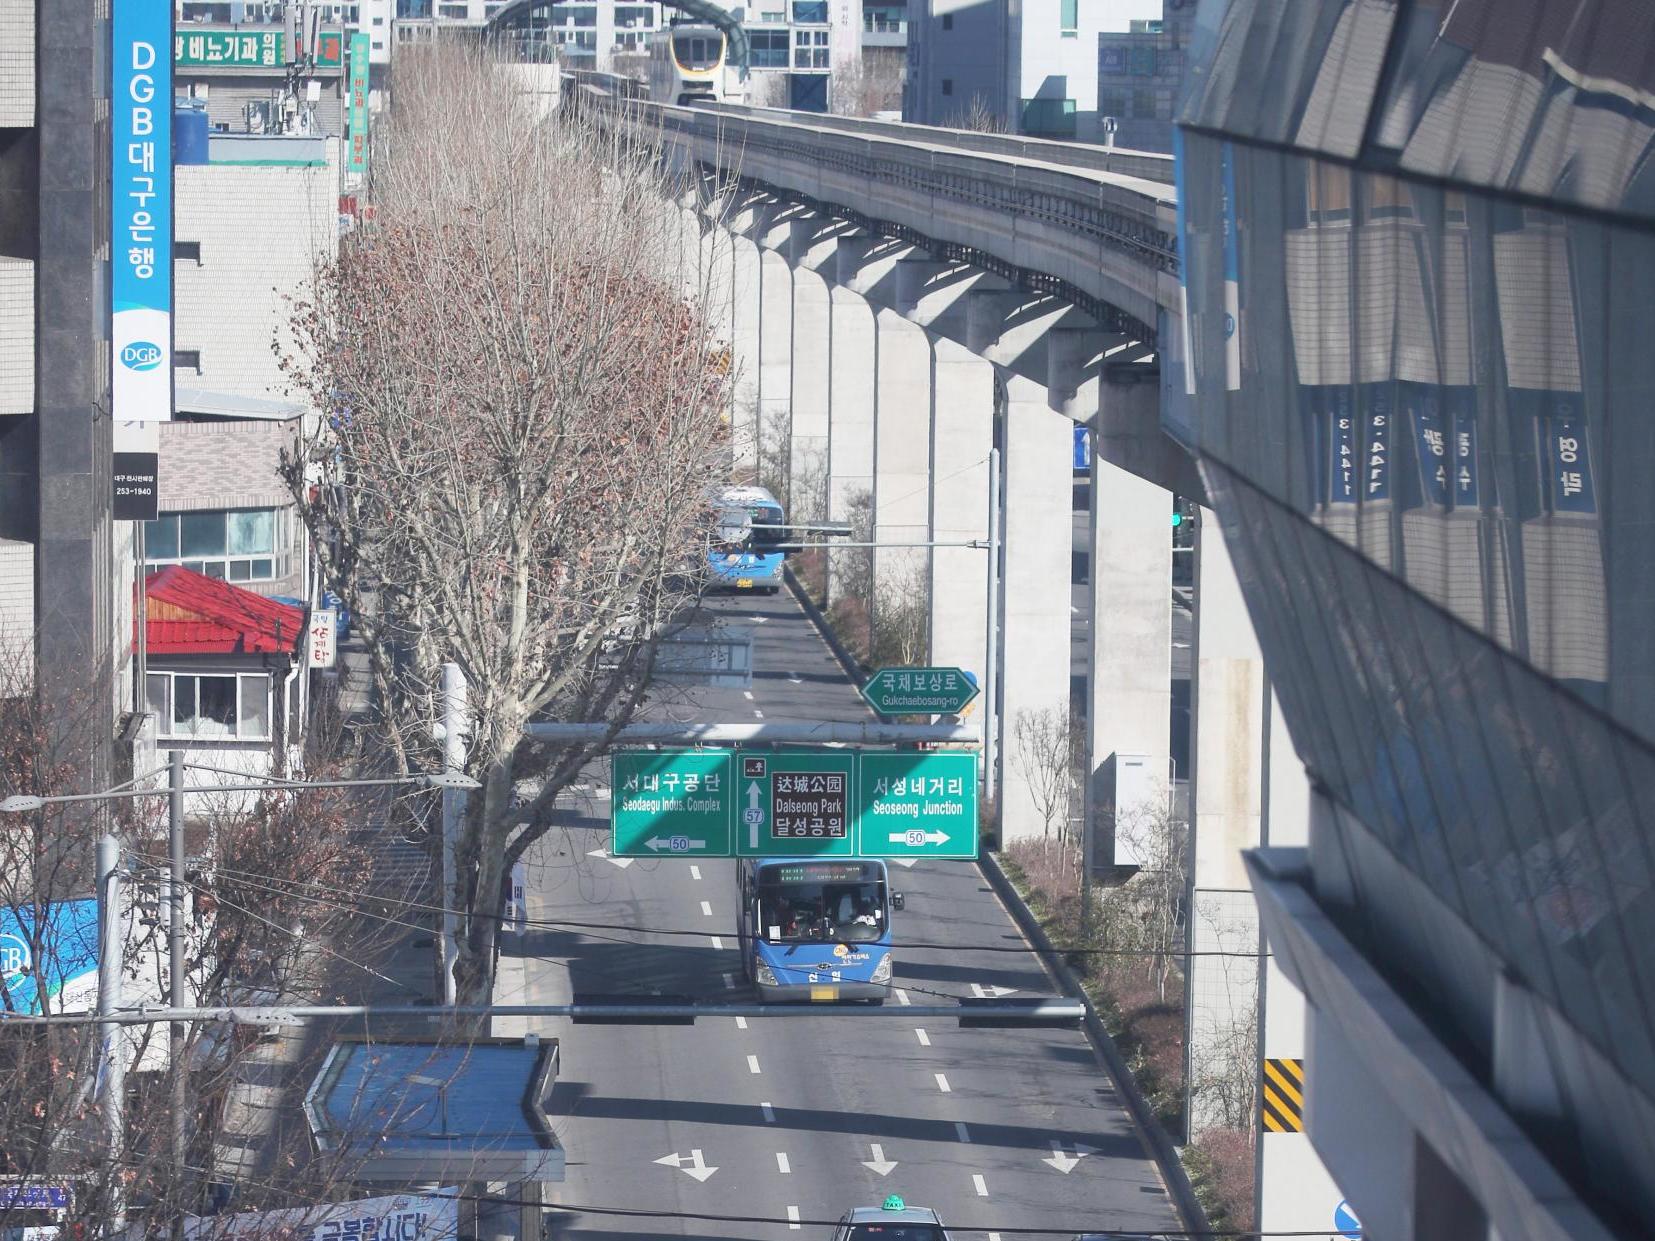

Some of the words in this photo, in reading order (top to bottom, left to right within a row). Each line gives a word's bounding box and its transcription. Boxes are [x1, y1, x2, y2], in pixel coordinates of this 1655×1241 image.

[188, 35, 257, 62] 비뇨기과
[262, 32, 275, 65] 의원
[124, 347, 161, 363] DGB
[116, 486, 152, 496] 253-1940
[882, 672, 958, 692] 국채보상로
[882, 694, 959, 708] Gukchaebosang-ro
[623, 773, 721, 792] 서대구공단
[777, 775, 842, 793] 达城公园
[873, 776, 963, 796] 서성네거리
[623, 796, 660, 814] Seodaegu
[662, 796, 686, 812] Indus.
[687, 796, 721, 814] Complex
[776, 798, 818, 816] Dalseong
[821, 799, 842, 813] Park
[873, 799, 918, 818] Seoseong
[923, 799, 963, 815] Junction
[746, 811, 762, 822] 57
[776, 817, 842, 837] 달성공원
[672, 838, 687, 850] 50
[909, 832, 923, 843] 50
